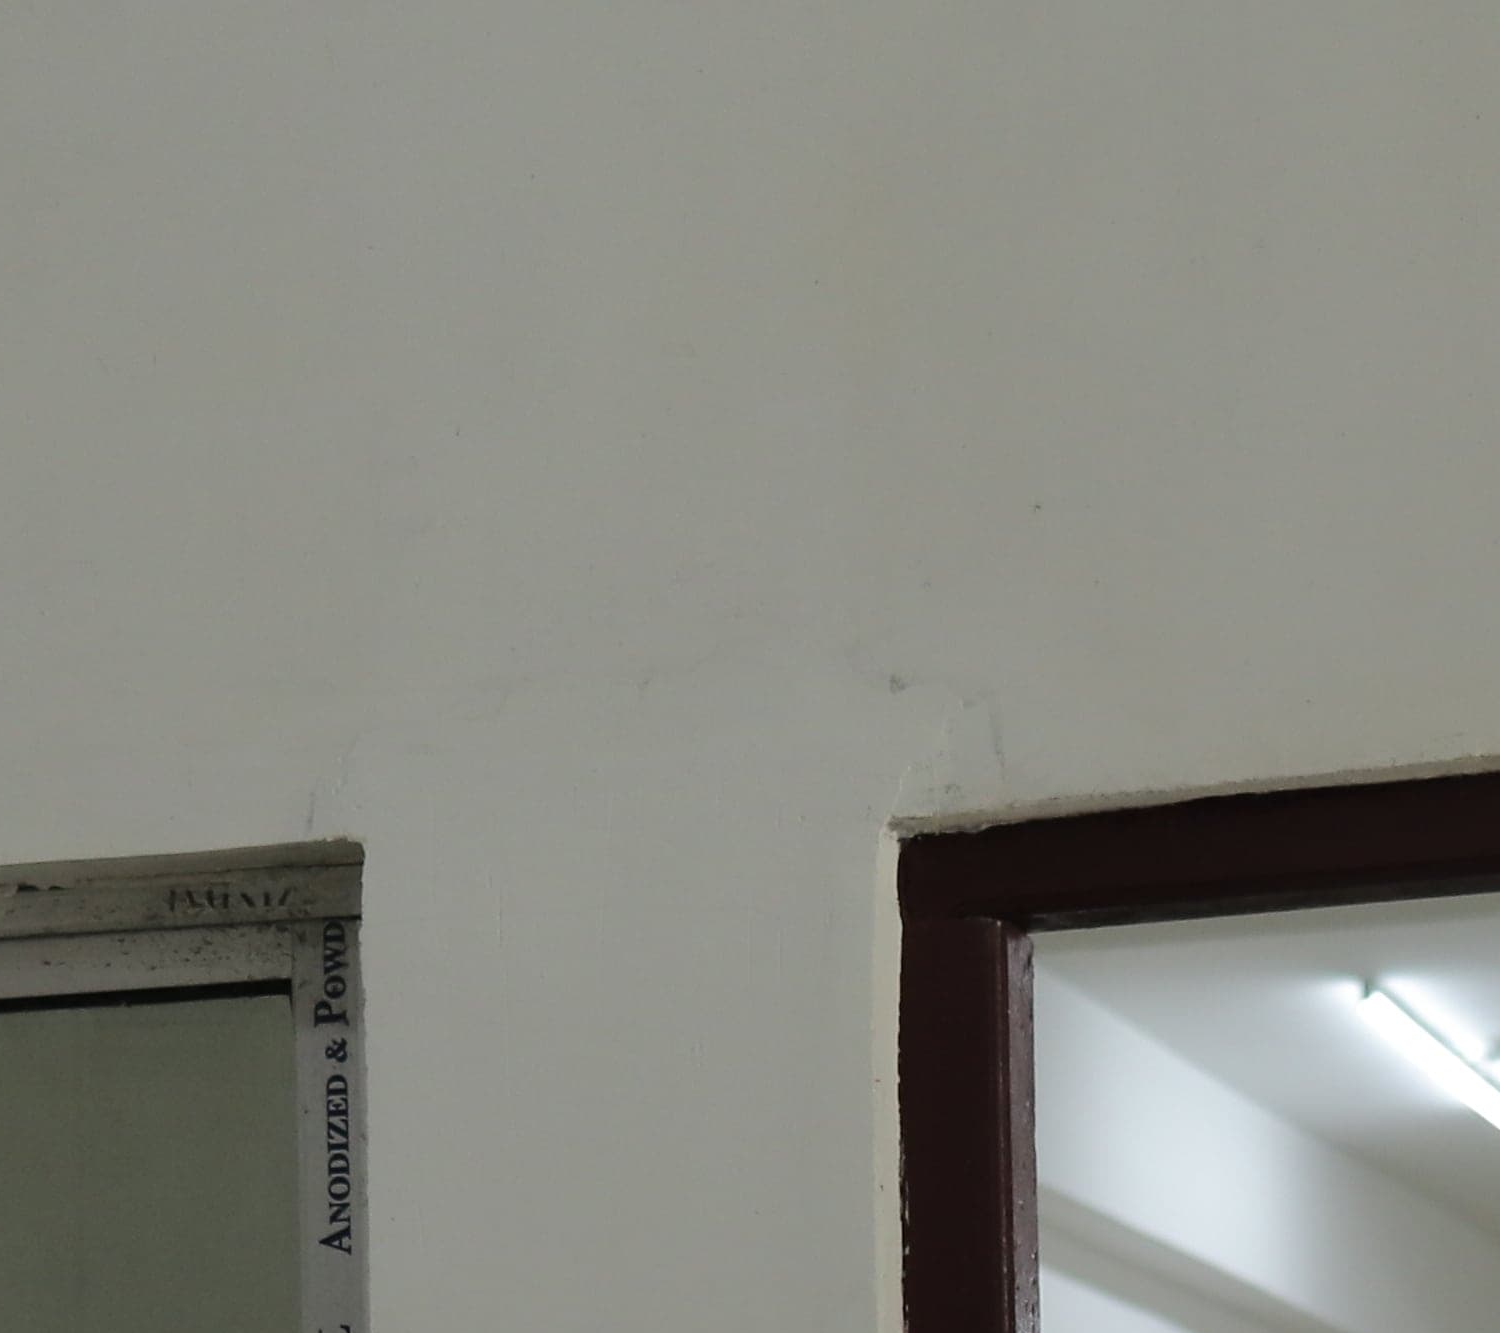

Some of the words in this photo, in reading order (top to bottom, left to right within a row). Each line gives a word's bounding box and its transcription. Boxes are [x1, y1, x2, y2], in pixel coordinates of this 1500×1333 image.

[314, 920, 350, 1028] POWD
[325, 1037, 349, 1063] &
[319, 1074, 352, 1256] ANODIZED
